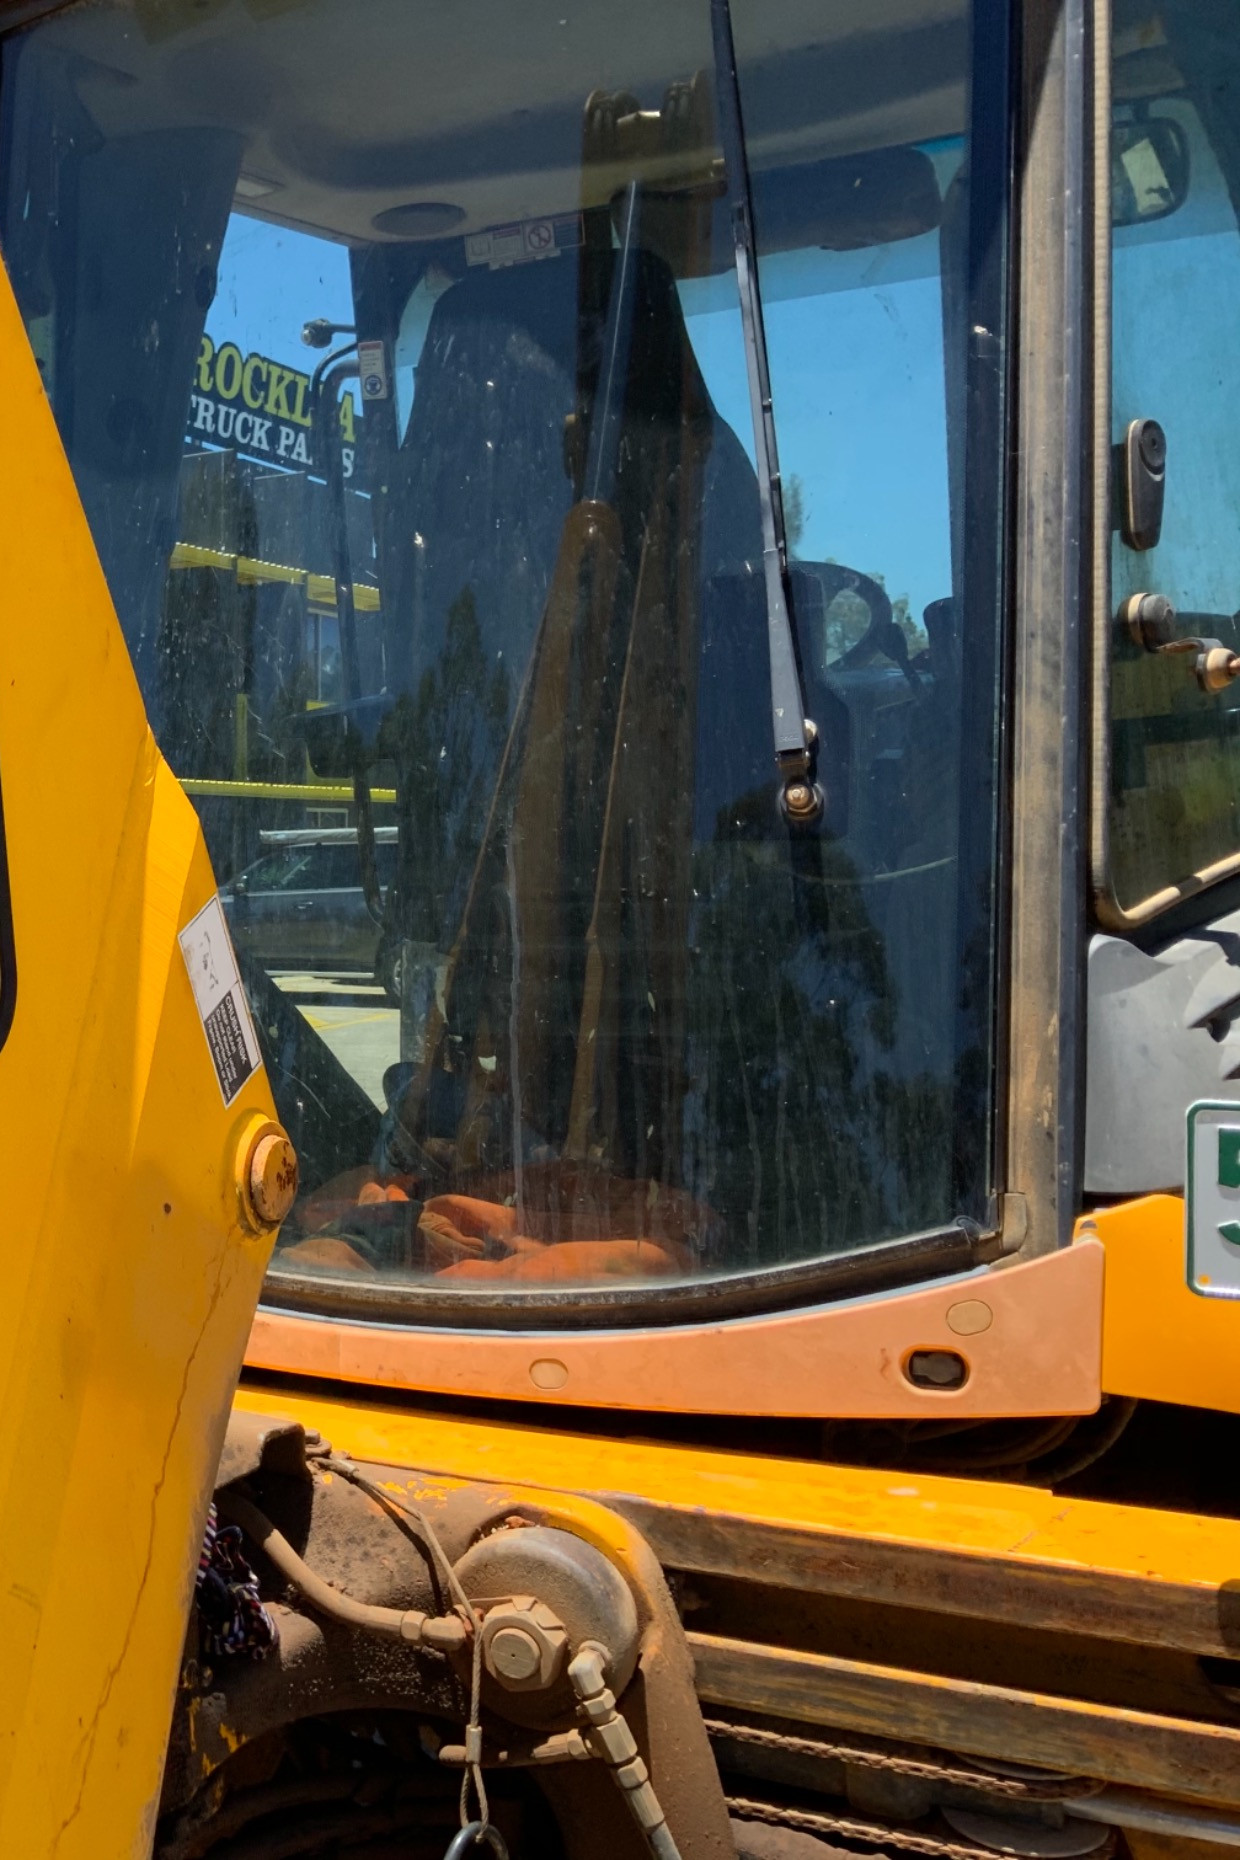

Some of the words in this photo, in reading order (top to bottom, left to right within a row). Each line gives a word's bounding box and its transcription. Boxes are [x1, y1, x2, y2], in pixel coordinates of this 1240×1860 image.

[193, 336, 356, 443] ROCKLA
[220, 1003, 229, 1026] KEEP
[225, 995, 241, 1037] CRUSH
[235, 1036, 248, 1065] RISK
